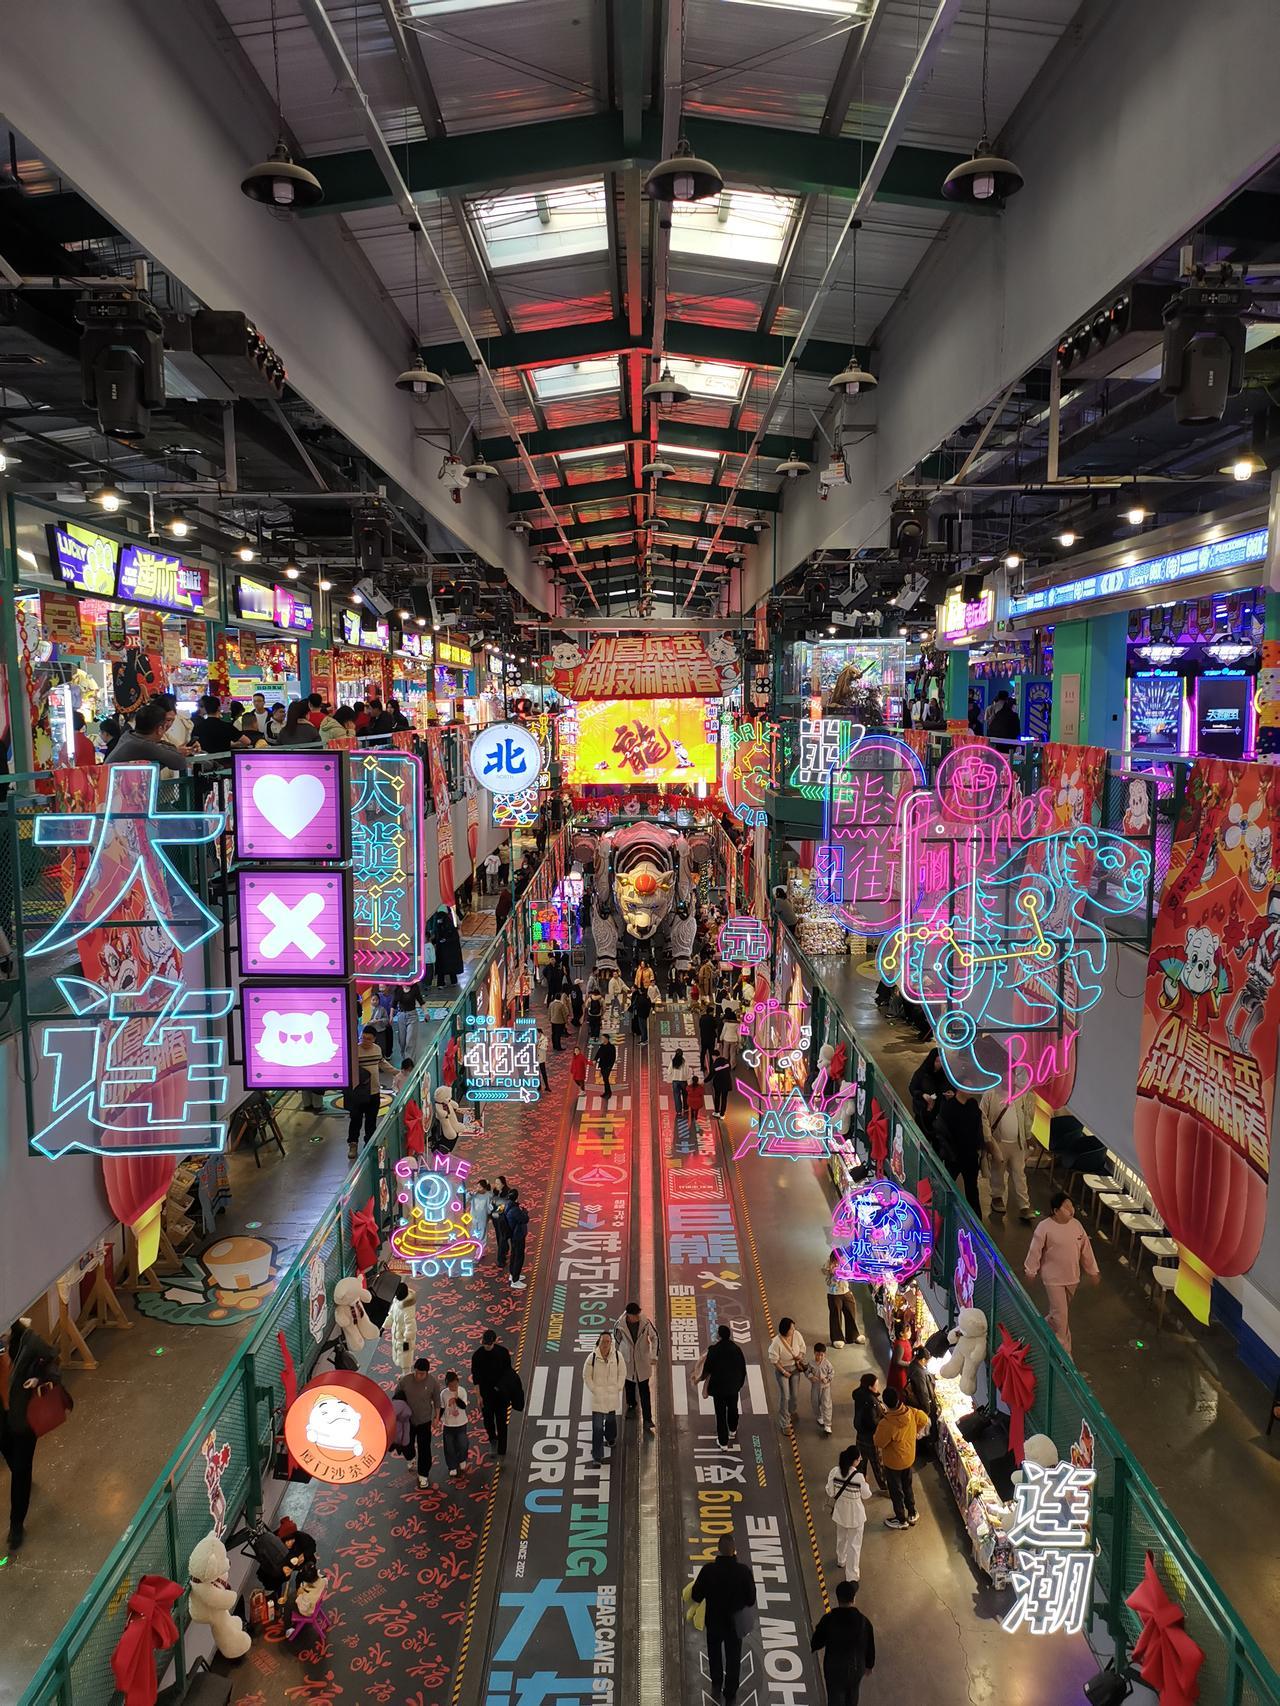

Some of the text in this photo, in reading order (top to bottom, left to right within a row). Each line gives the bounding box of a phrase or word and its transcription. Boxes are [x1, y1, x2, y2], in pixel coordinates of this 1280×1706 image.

[1128, 575, 1150, 588] LUCKY
[587, 636, 708, 663] AI喜乐季
[574, 663, 723, 697] 科技闹新春
[483, 738, 527, 775] 北
[611, 719, 672, 775] 龍
[23, 764, 235, 1161] 大连
[739, 998, 780, 1036] FOOD
[464, 1042, 540, 1077] 404
[778, 1025, 813, 1069] FOOD
[1155, 1016, 1264, 1106] AI喜乐季
[466, 1077, 541, 1088] NOT FOUND
[1004, 1030, 1080, 1105] Bar
[758, 1110, 833, 1140] ACG
[1138, 1050, 1270, 1174] 科技闹新春
[697, 1133, 716, 1156] SINCE
[395, 1154, 472, 1180] GAME
[852, 1239, 909, 1260] 水一方
[405, 1259, 474, 1278] TOYS
[547, 1313, 564, 1340] CAUTION
[299, 1448, 377, 1481] 厦门沙茶面
[524, 1418, 571, 1513] FOR U
[751, 1435, 764, 1464] SINCE 2022
[565, 1419, 612, 1577] WAITING
[514, 1540, 529, 1578] SINCE 2022
[1002, 1460, 1098, 1635] 连潮
[745, 1515, 808, 1706] HOW TIME
[591, 1678, 615, 1706] ST
